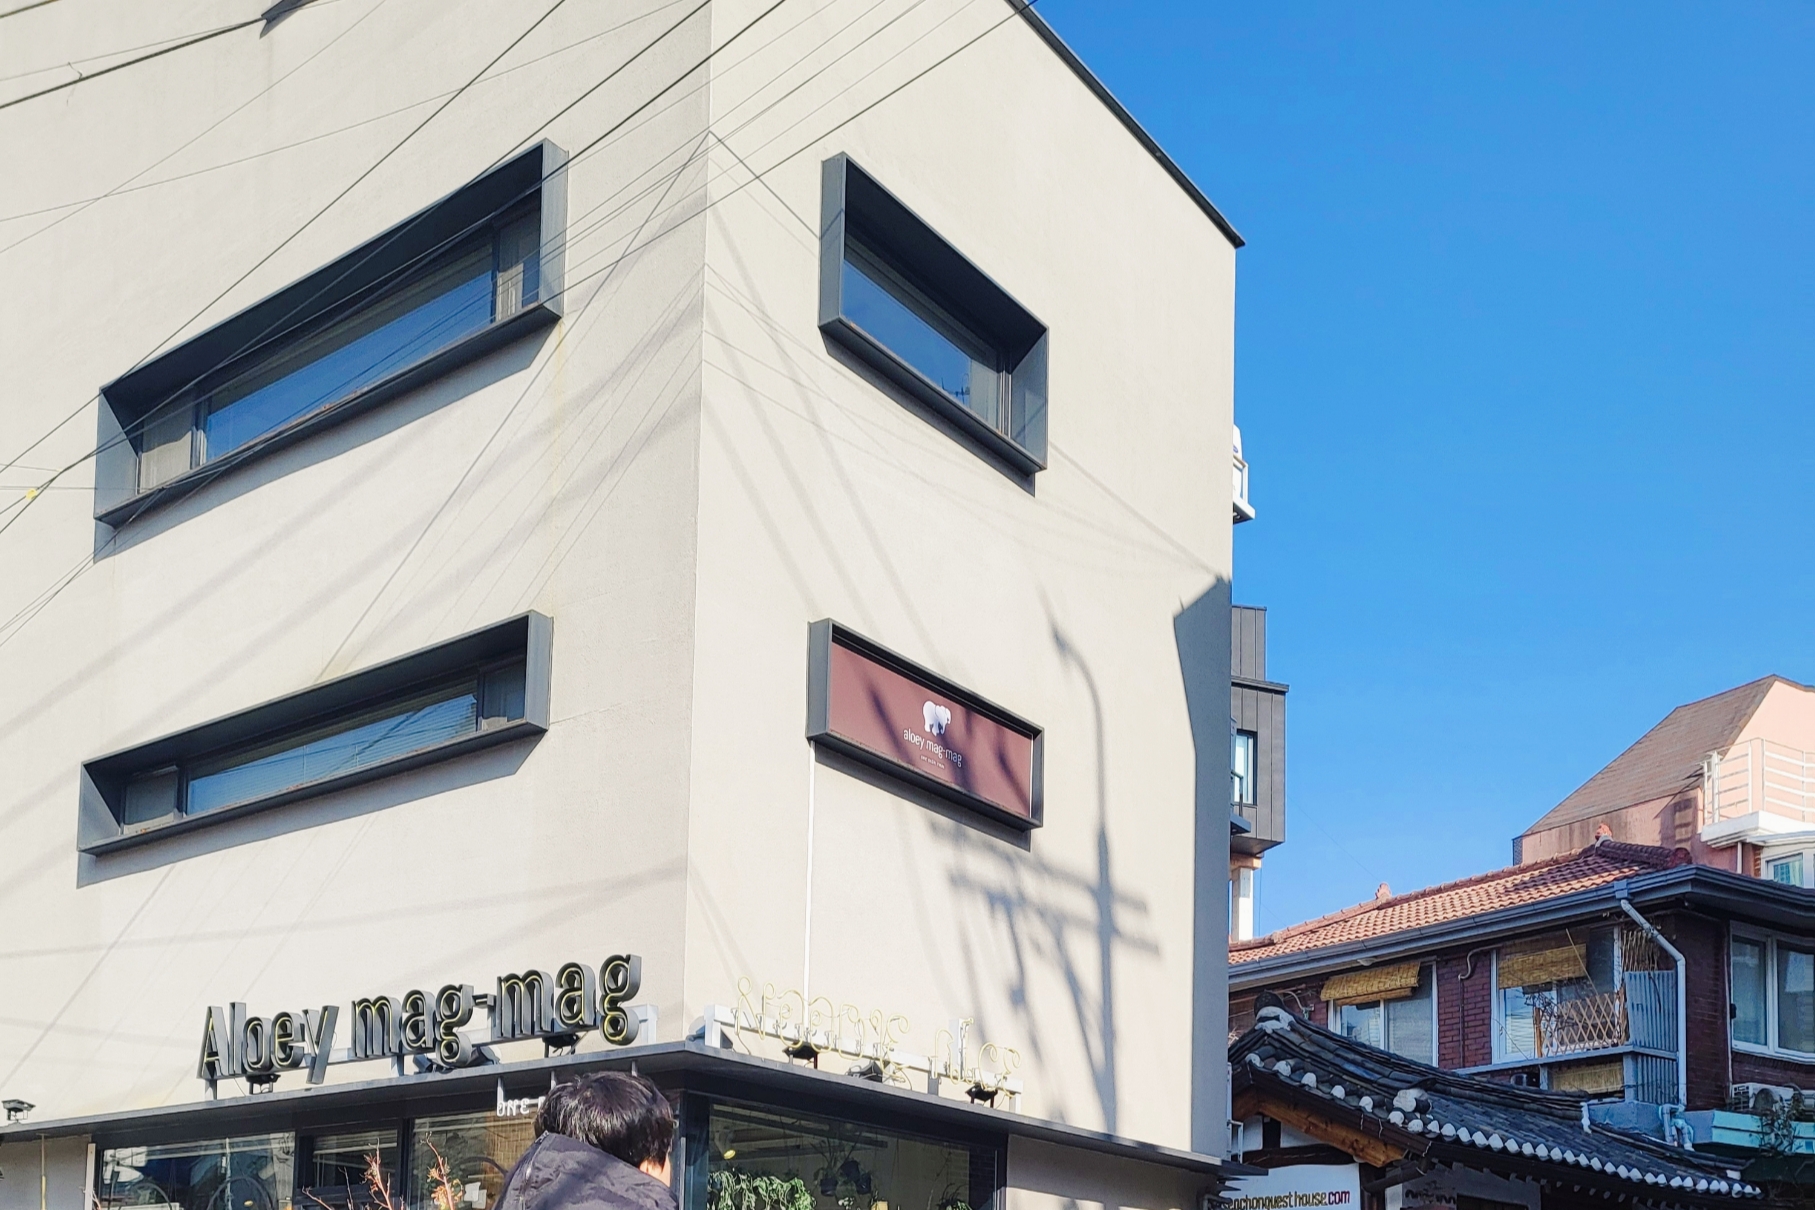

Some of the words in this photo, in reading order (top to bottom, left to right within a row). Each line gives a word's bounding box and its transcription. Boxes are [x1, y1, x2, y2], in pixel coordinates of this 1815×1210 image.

[903, 729, 925, 750] aloey
[926, 739, 962, 768] mag-mag
[197, 1002, 339, 1085] Aloey
[351, 954, 642, 1068] mag-mag
